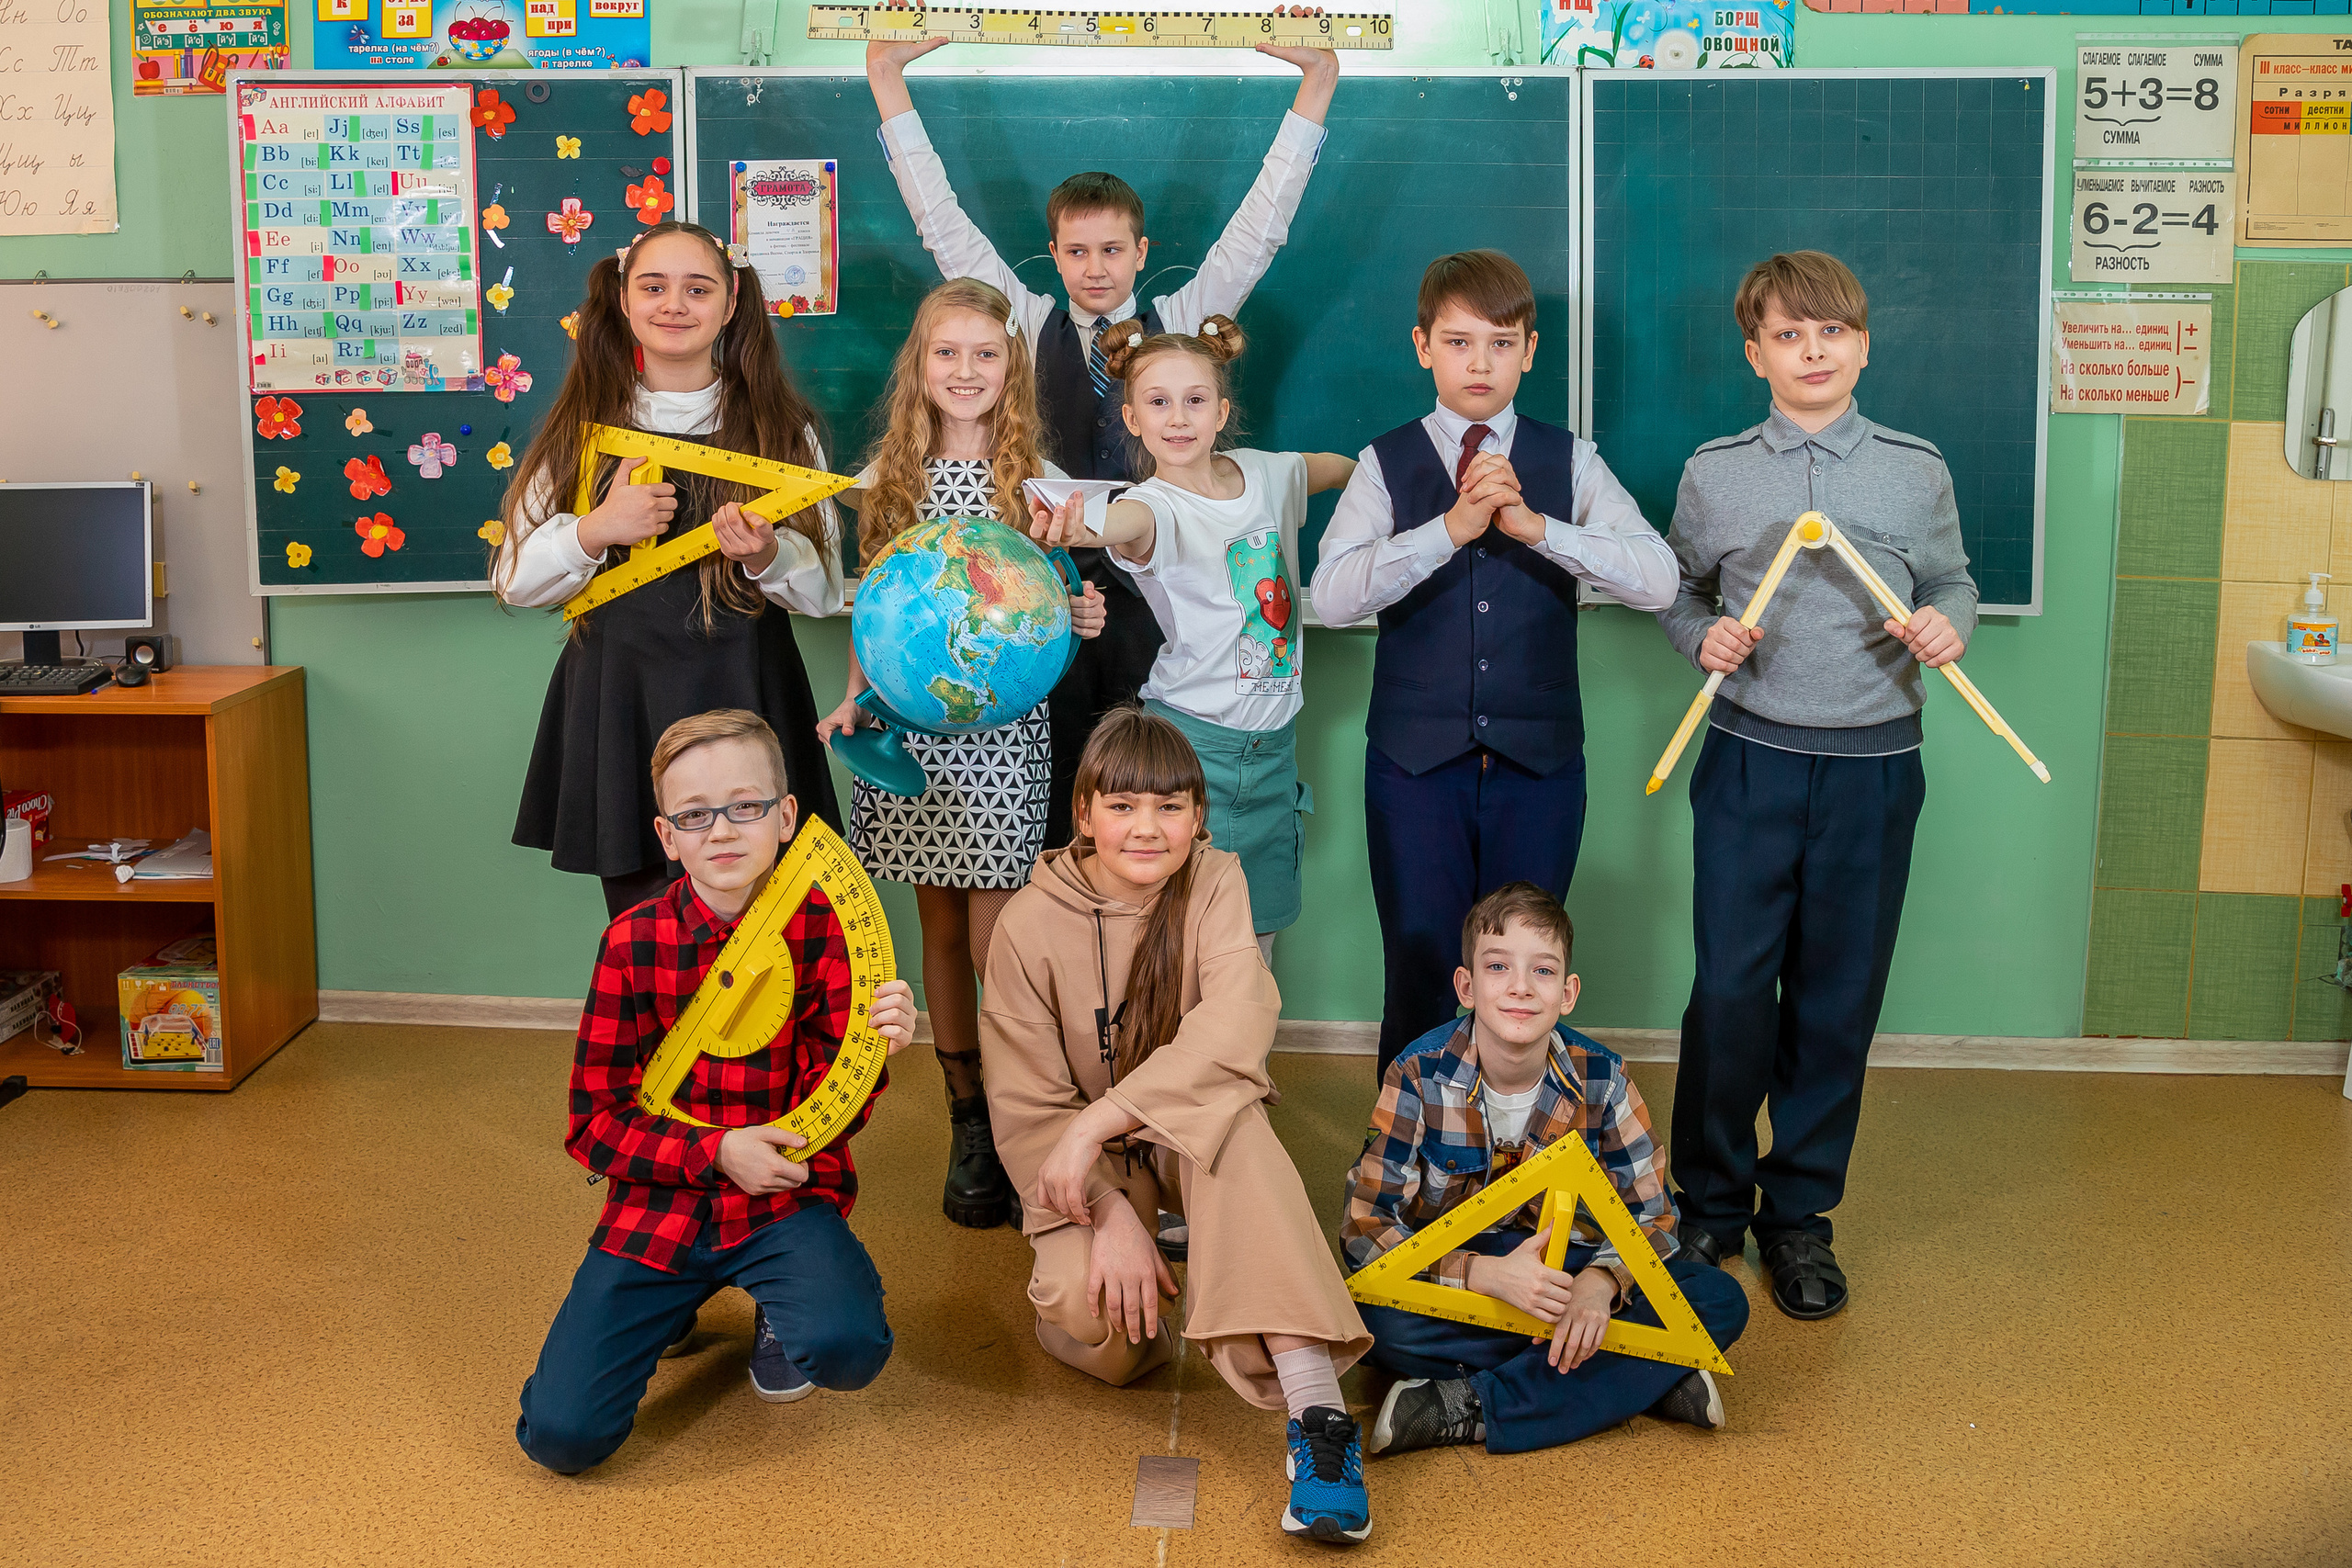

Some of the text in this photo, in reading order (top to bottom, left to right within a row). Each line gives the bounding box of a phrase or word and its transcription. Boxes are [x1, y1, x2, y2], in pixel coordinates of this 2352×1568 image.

[143, 8, 272, 19] ОБОЗНАЧАЮТ ДВА ЗВУКА
[530, 4, 555, 17] над
[595, 1, 639, 13] вокруг
[188, 19, 198, 33] ё
[398, 15, 414, 27] за
[547, 20, 572, 33] при
[857, 12, 1389, 34] 1 2 3 4 5 6 7 8 9 10
[1714, 11, 1759, 28] БОРЩ
[348, 45, 389, 55] тарелка
[391, 44, 408, 54] (на
[1703, 35, 1780, 53] ОВОЩНОЙ
[385, 56, 414, 64] столе
[527, 49, 560, 58] ягоды
[2082, 52, 2223, 67] СЛАГАЕМОЕ СЛАГАЕМОЕ СУММА
[552, 60, 593, 69] тарелке
[269, 94, 446, 108] АНГЛИЙСКИЙ АЛФАВИТ
[2264, 106, 2344, 116] сотни десятки
[261, 119, 289, 134] Aa
[329, 118, 348, 138] Jj
[397, 118, 420, 134] Ss
[2103, 130, 2140, 144] СУММА
[262, 145, 289, 161] Bb
[329, 145, 360, 161] Kk
[397, 145, 421, 161] Tt
[761, 185, 807, 193] ГРАМОТА
[2131, 179, 2176, 193] ВЫЧИТАЕМОЕ
[2189, 180, 2224, 194] РАЗНОСТЬ
[265, 202, 293, 218] Dd
[332, 202, 369, 217] Mm
[266, 231, 290, 246] Ee
[333, 231, 360, 246] Nn
[266, 258, 431, 274] Ff Oo Xx
[2096, 256, 2150, 270] РАЗНОСТЬ
[267, 286, 428, 306] Gg Pp Yy
[268, 315, 299, 332] Hh
[335, 314, 364, 333] Qq
[402, 313, 427, 329] Zz
[2062, 321, 2109, 333] Увеличить
[2135, 325, 2169, 336] единиц
[337, 343, 363, 357] Rr
[2062, 337, 2111, 350] Уменьшить
[2139, 341, 2172, 352] единиц
[2061, 359, 2169, 376] На сколько больше
[2060, 385, 2169, 402] На сколько меньше
[22, 795, 47, 813] Choco
[831, 858, 843, 873] 170
[848, 883, 860, 898] 160
[861, 911, 871, 928] 150
